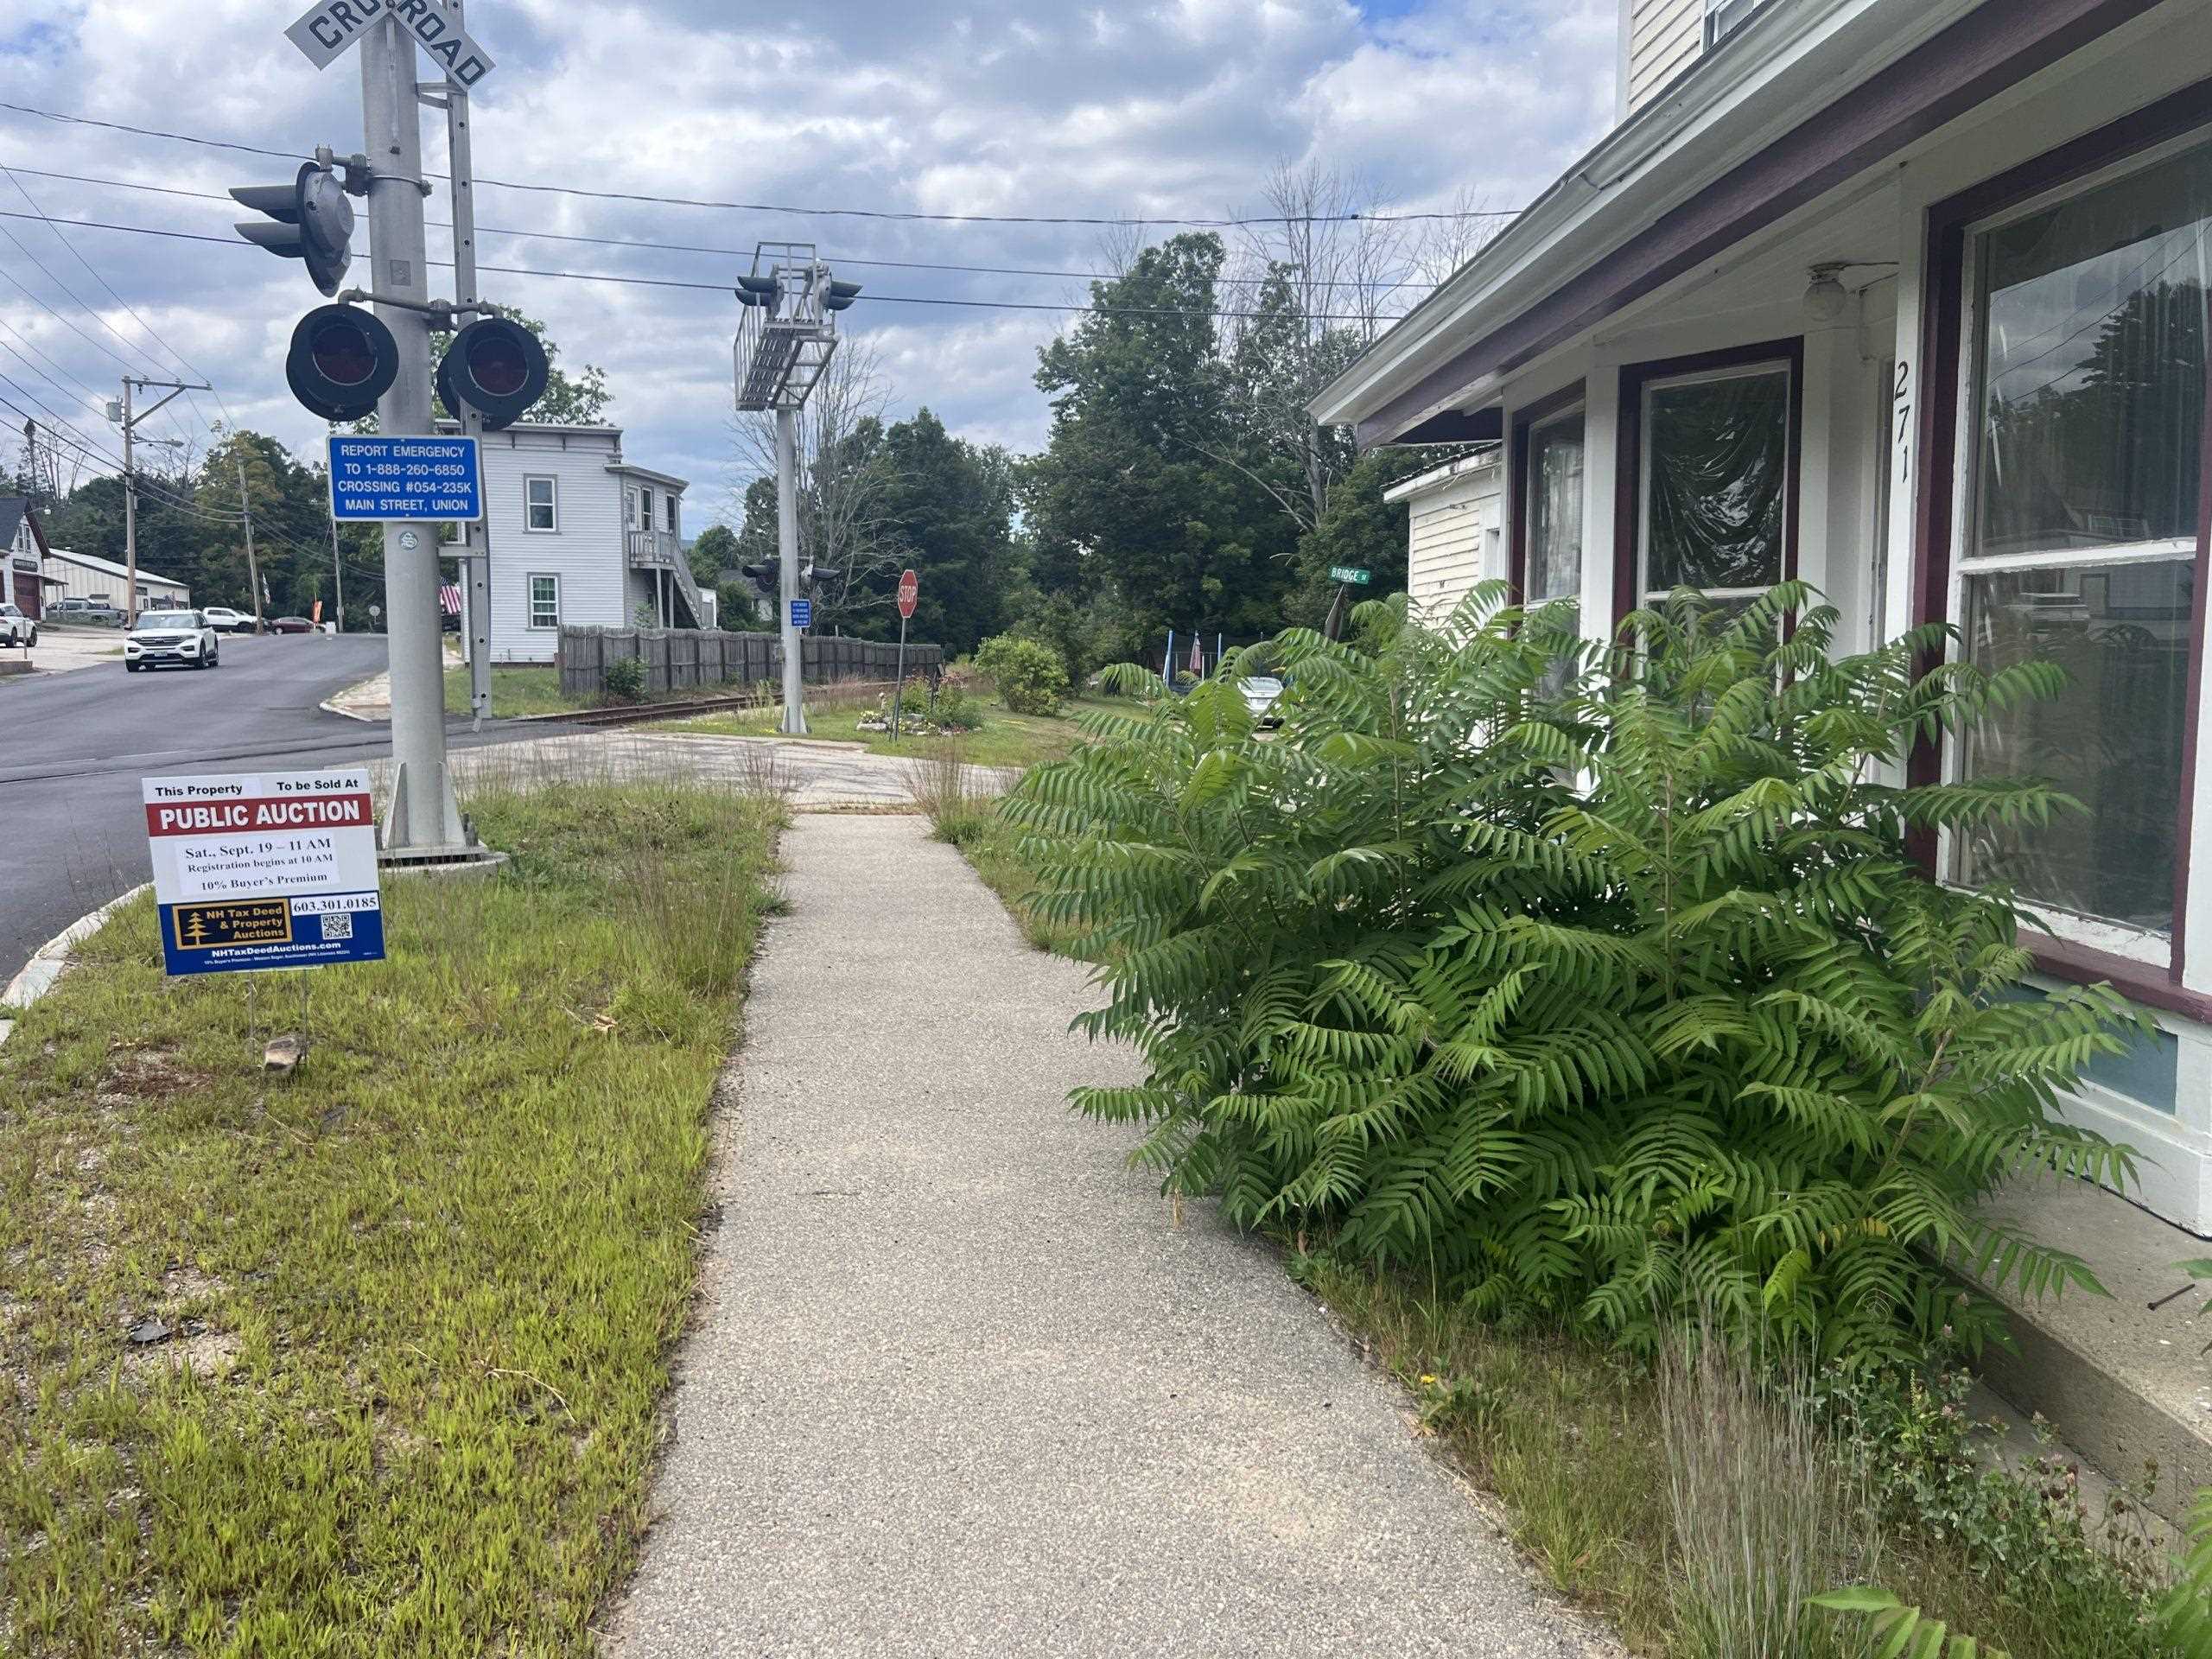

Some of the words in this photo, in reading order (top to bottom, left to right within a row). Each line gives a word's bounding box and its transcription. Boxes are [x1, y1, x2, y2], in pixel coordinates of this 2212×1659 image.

[397, 0, 486, 86] ROAD
[1894, 361, 1910, 483] 271
[340, 445, 388, 457] REPORT
[393, 446, 465, 458] EMERGENCY
[344, 463, 361, 475] TO
[365, 463, 465, 476] 1-888-260-6850
[338, 480, 401, 493] CROSSING
[405, 481, 473, 494] #054-235K
[345, 499, 375, 511] MAIN
[380, 499, 429, 512] STREET,
[432, 499, 469, 512] UNION
[1331, 567, 1360, 581] BRIDGE
[899, 585, 917, 603] STOP
[156, 786, 184, 797] This
[188, 784, 243, 796] Property
[276, 782, 292, 791] To
[296, 781, 310, 791] be
[315, 779, 341, 790] Sold
[345, 779, 359, 788] At
[160, 804, 250, 830] PUBLIC
[256, 799, 360, 825] AUCTION
[219, 844, 253, 859] Sept.
[258, 842, 273, 854] 19
[289, 840, 302, 852] 11
[307, 838, 332, 849] AM
[188, 861, 251, 874] Registration
[253, 859, 286, 868] begins
[315, 854, 333, 862] AM
[201, 880, 227, 891] 10%
[277, 874, 327, 885] Premium
[207, 910, 225, 920] NH
[228, 909, 250, 918] Tax
[253, 906, 283, 916] Deed
[294, 897, 377, 913] 603.301.0185
[219, 920, 229, 930] &
[232, 918, 283, 929] Property
[233, 929, 285, 940] Auctions
[211, 941, 342, 957] NHTaxDeedAuctions.com
